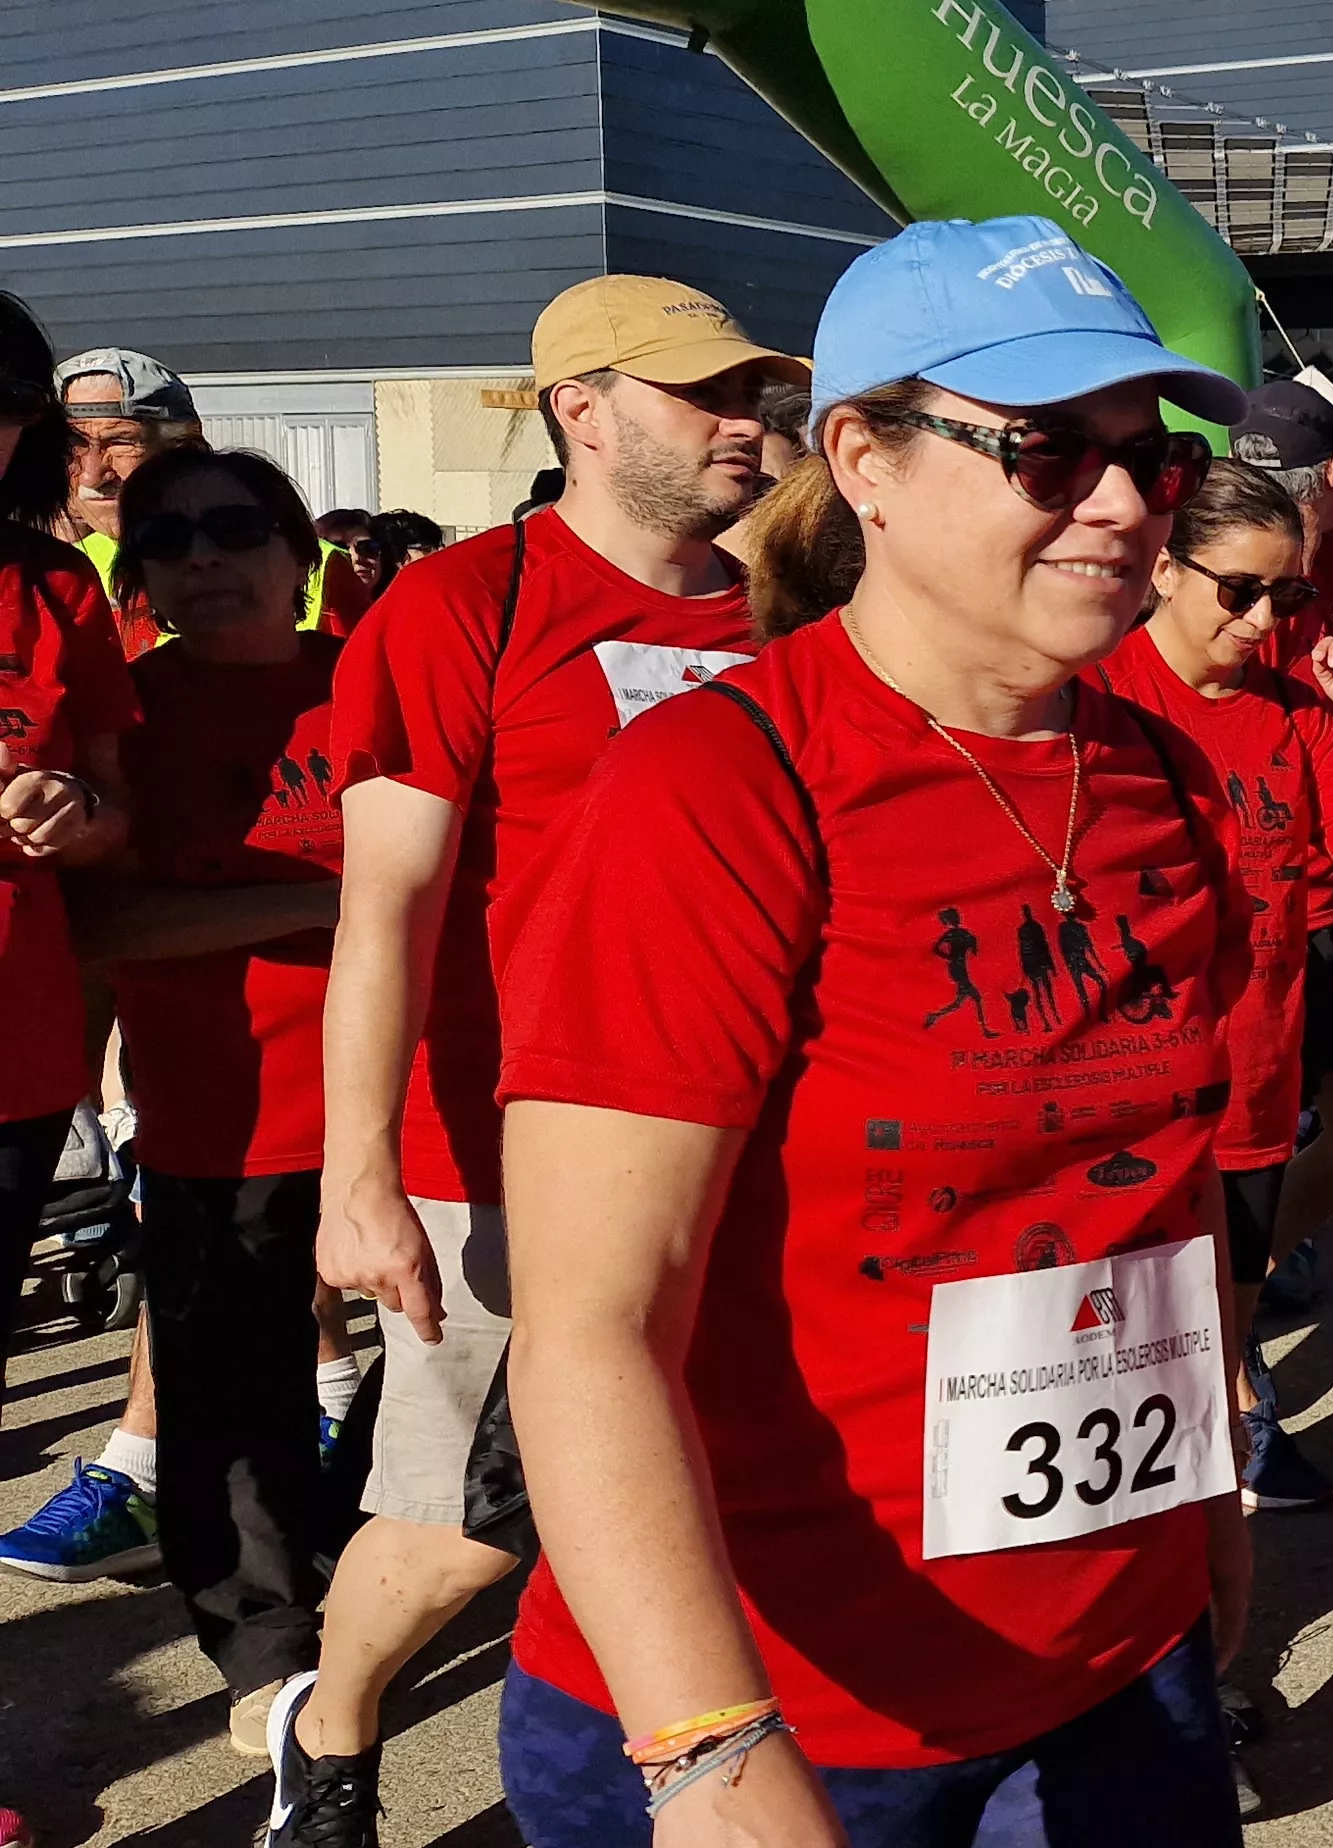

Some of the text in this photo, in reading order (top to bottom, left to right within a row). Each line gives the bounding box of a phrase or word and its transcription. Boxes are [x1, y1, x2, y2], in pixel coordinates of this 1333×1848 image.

[930, 0, 1158, 230] Huesca
[995, 247, 1066, 289] DIOCESIS
[622, 688, 656, 702] MARCHA
[972, 1044, 1056, 1069] MARCHA
[1060, 1035, 1151, 1063] SOLIDARIA
[946, 1370, 1007, 1402] MARCHA
[1010, 1362, 1076, 1396] SOLIDARIA
[1078, 1356, 1100, 1382] POR
[1101, 1352, 1116, 1379] LA
[1116, 1335, 1168, 1374] ESCLEROSIS
[1001, 1393, 1177, 1519] 332
